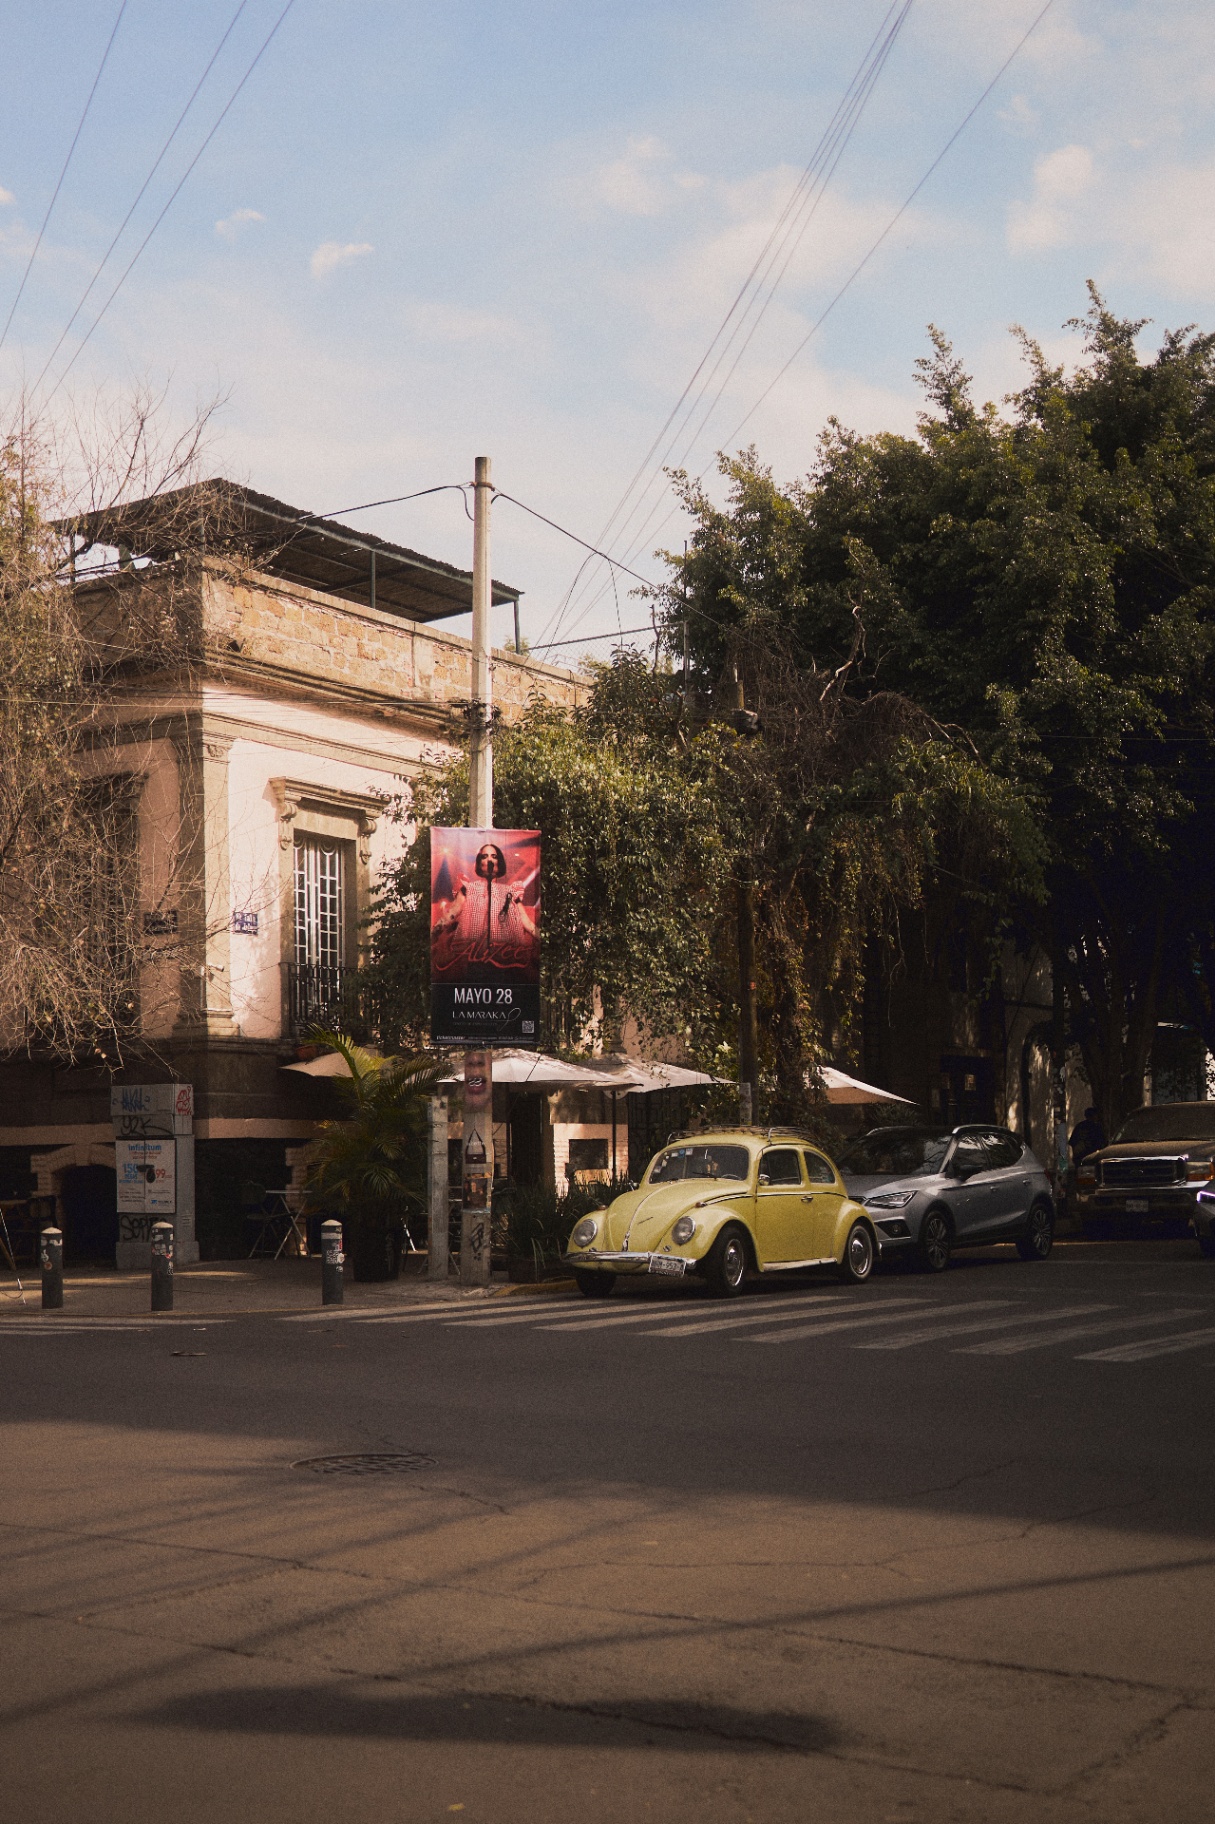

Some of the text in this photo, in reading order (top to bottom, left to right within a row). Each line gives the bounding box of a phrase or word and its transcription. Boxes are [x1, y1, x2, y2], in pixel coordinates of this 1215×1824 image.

[454, 987, 513, 1004] MAYO 28
[128, 1143, 162, 1151] infinitum
